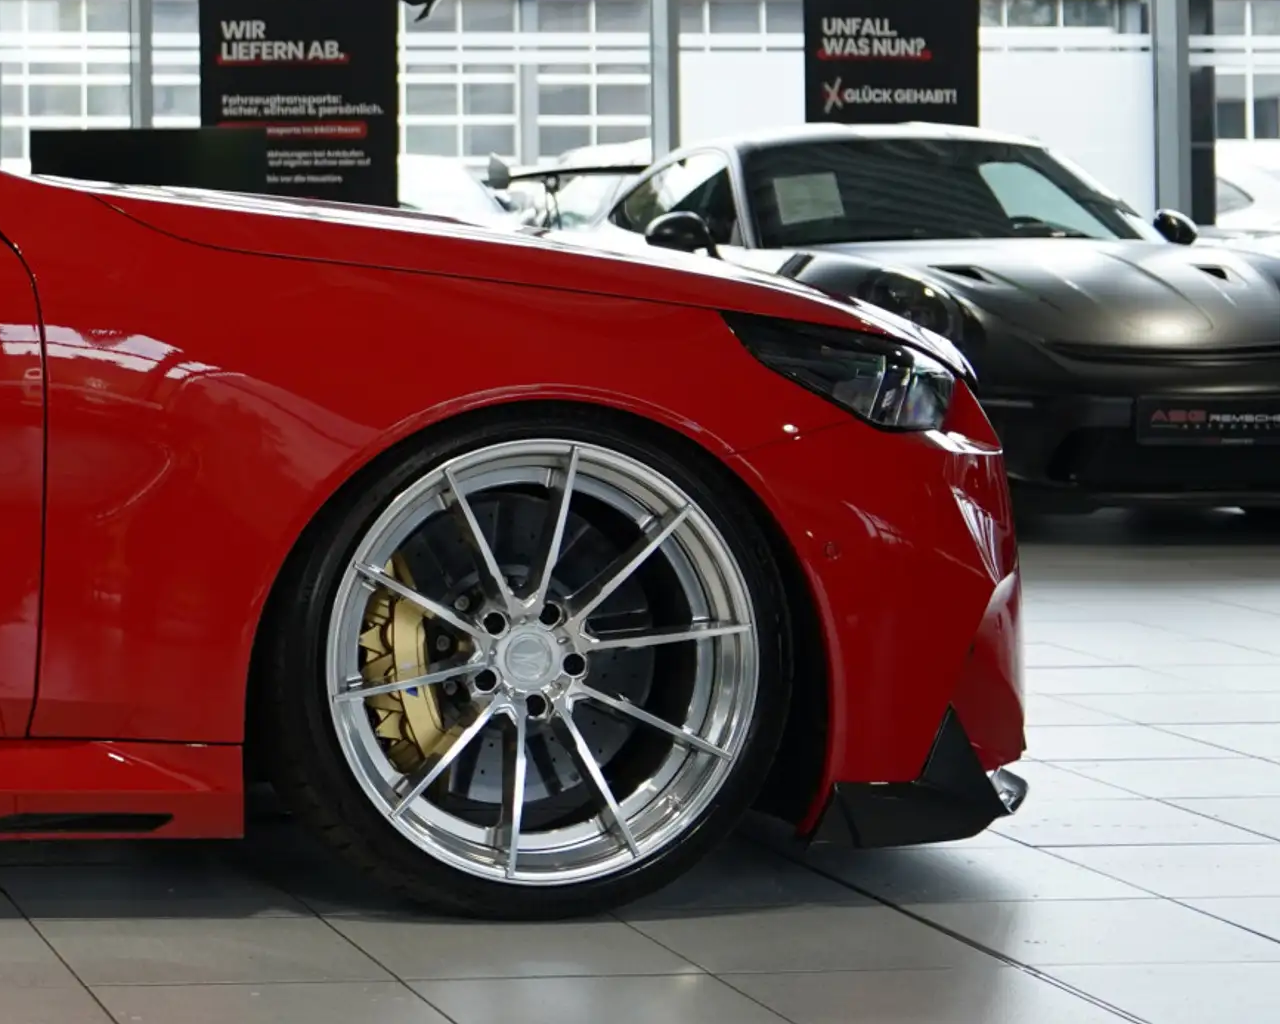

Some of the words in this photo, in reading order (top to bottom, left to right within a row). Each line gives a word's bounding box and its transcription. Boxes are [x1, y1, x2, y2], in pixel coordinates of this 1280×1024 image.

[220, 20, 267, 39] WIR
[220, 41, 304, 61] LIEFERN
[308, 41, 344, 60] AB.
[823, 38, 871, 56] WAS
[873, 37, 926, 56] NUN?
[844, 86, 892, 104] GLÜCK
[894, 88, 957, 104] GEHABT!
[222, 104, 261, 117] sicher,
[263, 104, 307, 116] schnell
[308, 104, 317, 116] &
[318, 104, 384, 118] persönlich.
